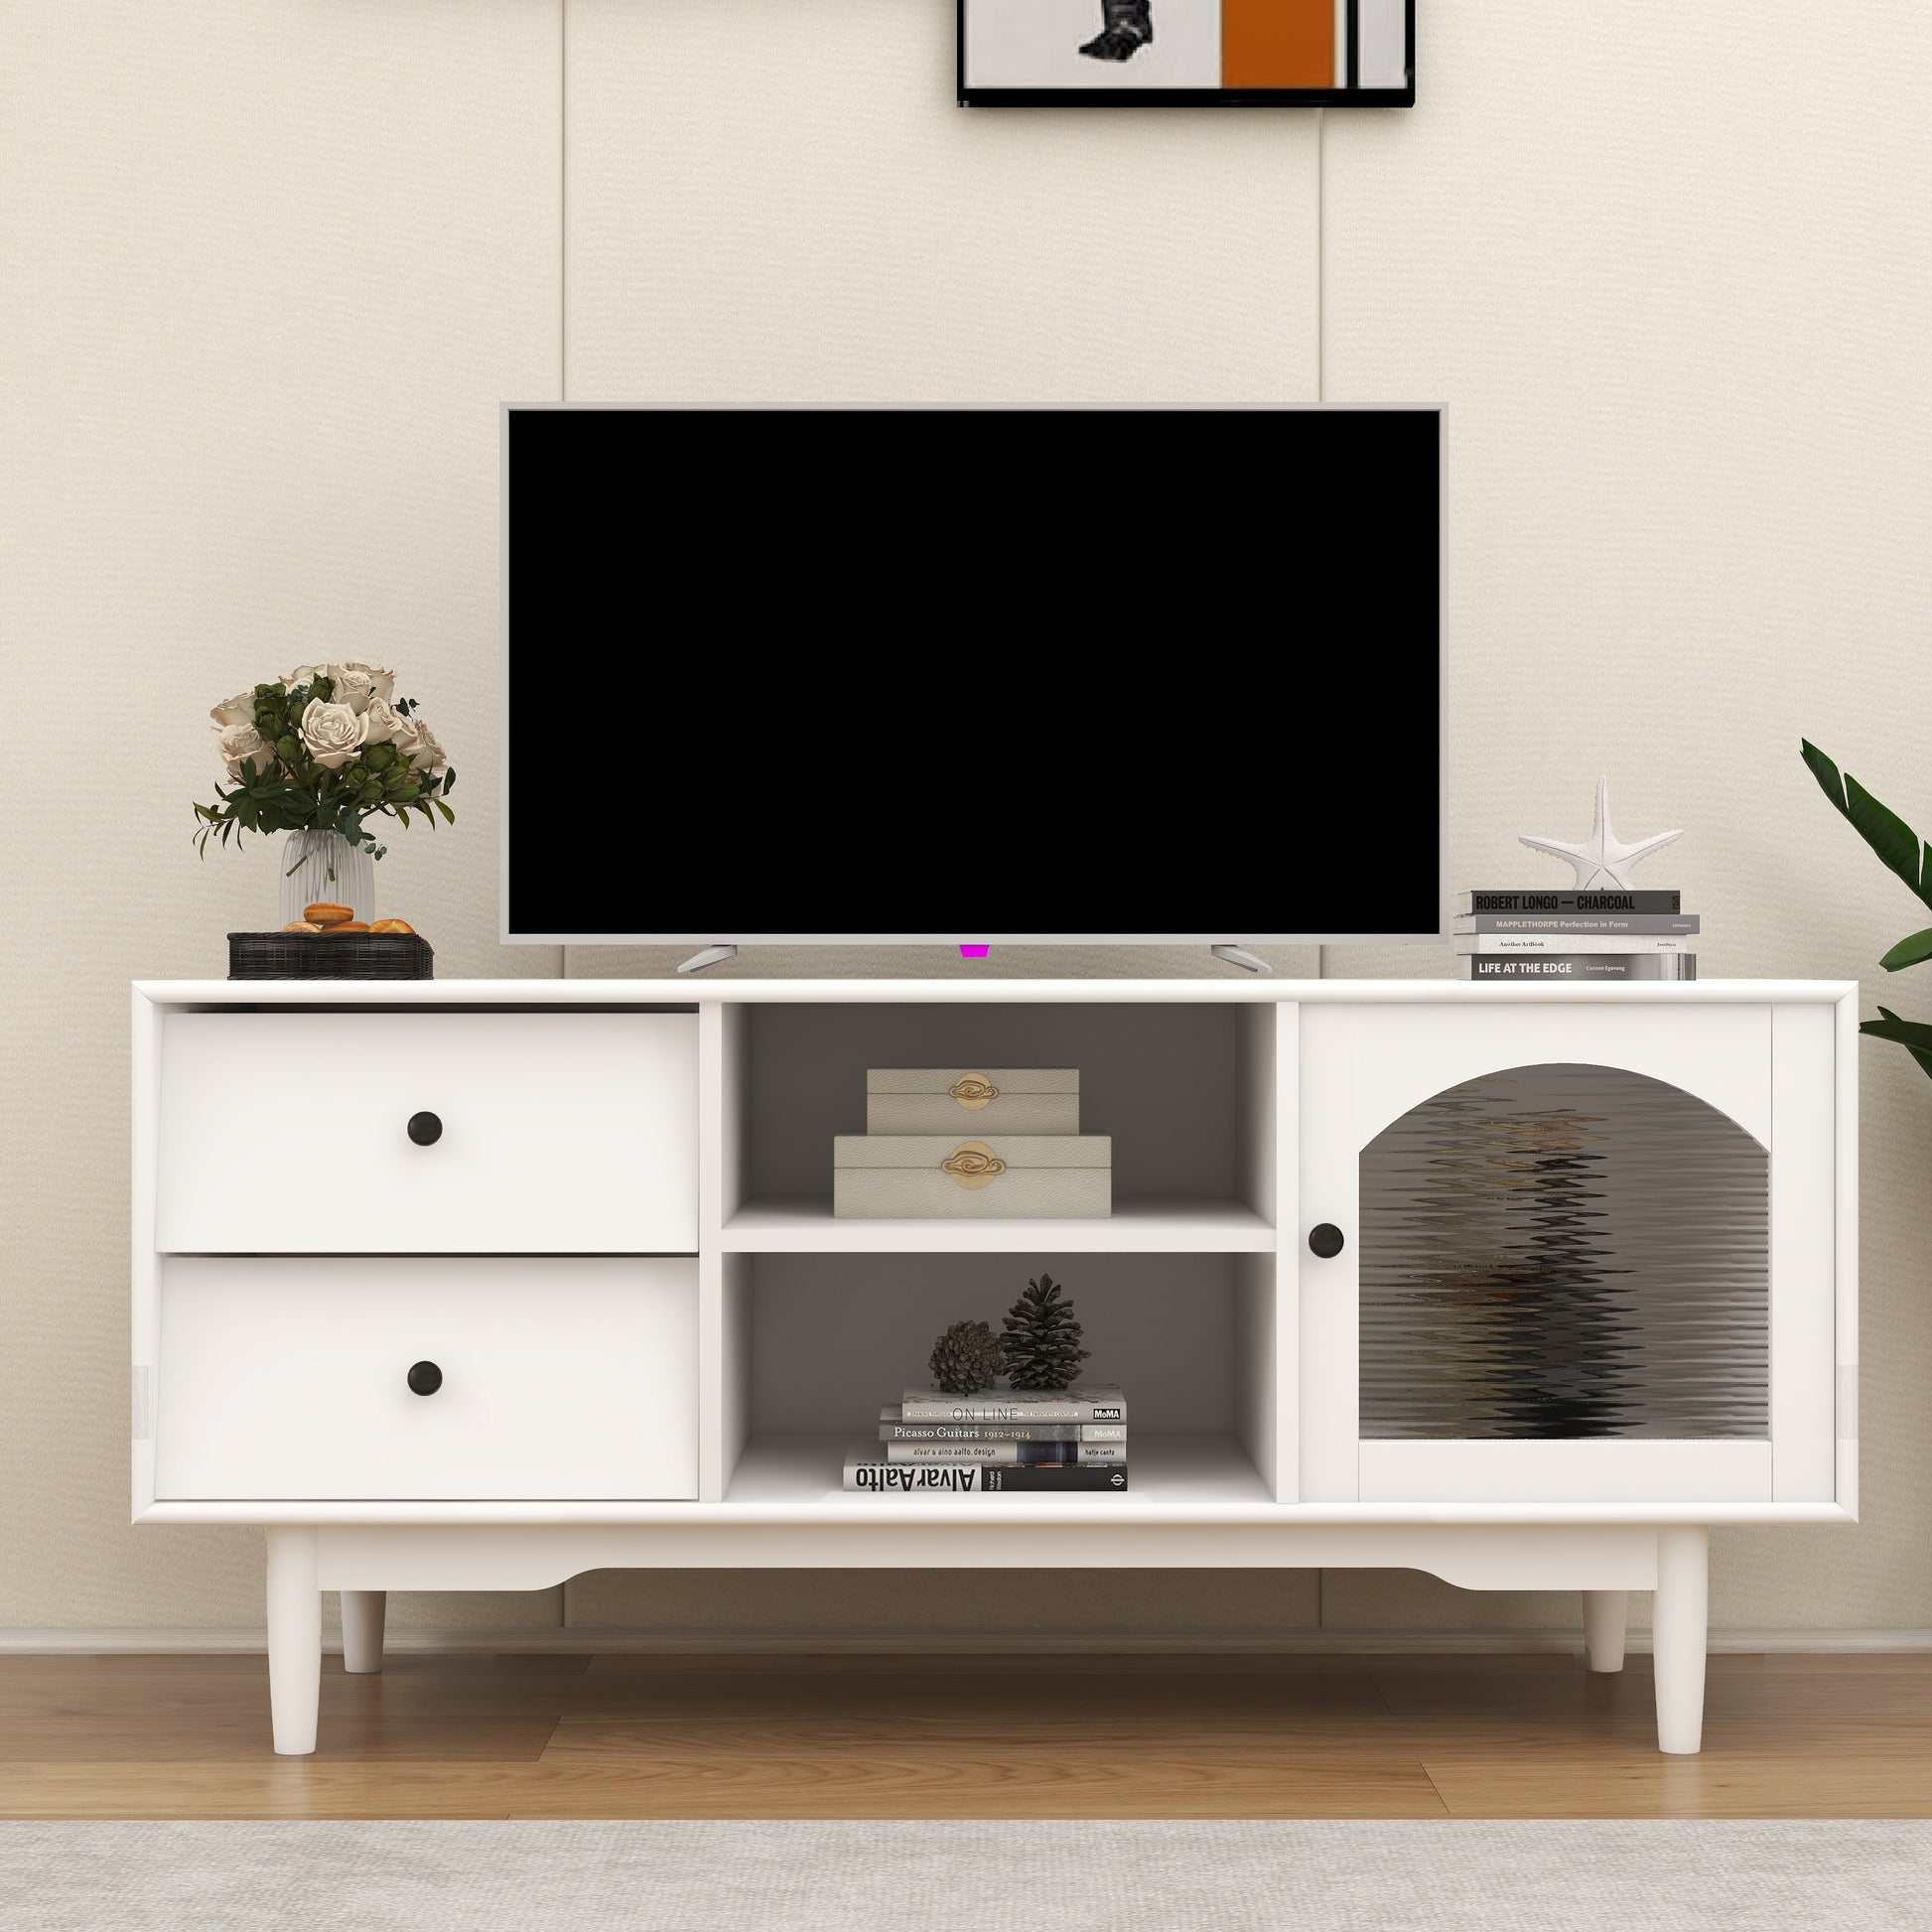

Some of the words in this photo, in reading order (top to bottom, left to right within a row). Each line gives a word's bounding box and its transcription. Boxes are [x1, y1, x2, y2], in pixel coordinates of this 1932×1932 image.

[1475, 896, 1519, 910] ROBERT
[1522, 896, 1559, 910] LONGO
[1577, 896, 1635, 910] CHARCOAL
[1478, 963, 1501, 974] LIFE
[1503, 963, 1518, 974] AT
[1519, 963, 1541, 974] THE
[1543, 963, 1573, 974] EDGE
[952, 1407, 979, 1421] ON
[983, 1407, 1019, 1421] LINE
[1094, 1409, 1120, 1419] MoMA
[894, 1426, 934, 1439] Picasso
[936, 1426, 980, 1439] Guitars
[1095, 1429, 1122, 1439] MoMA
[913, 1448, 930, 1456] alvar
[938, 1448, 952, 1456] aino
[974, 1448, 996, 1457] design
